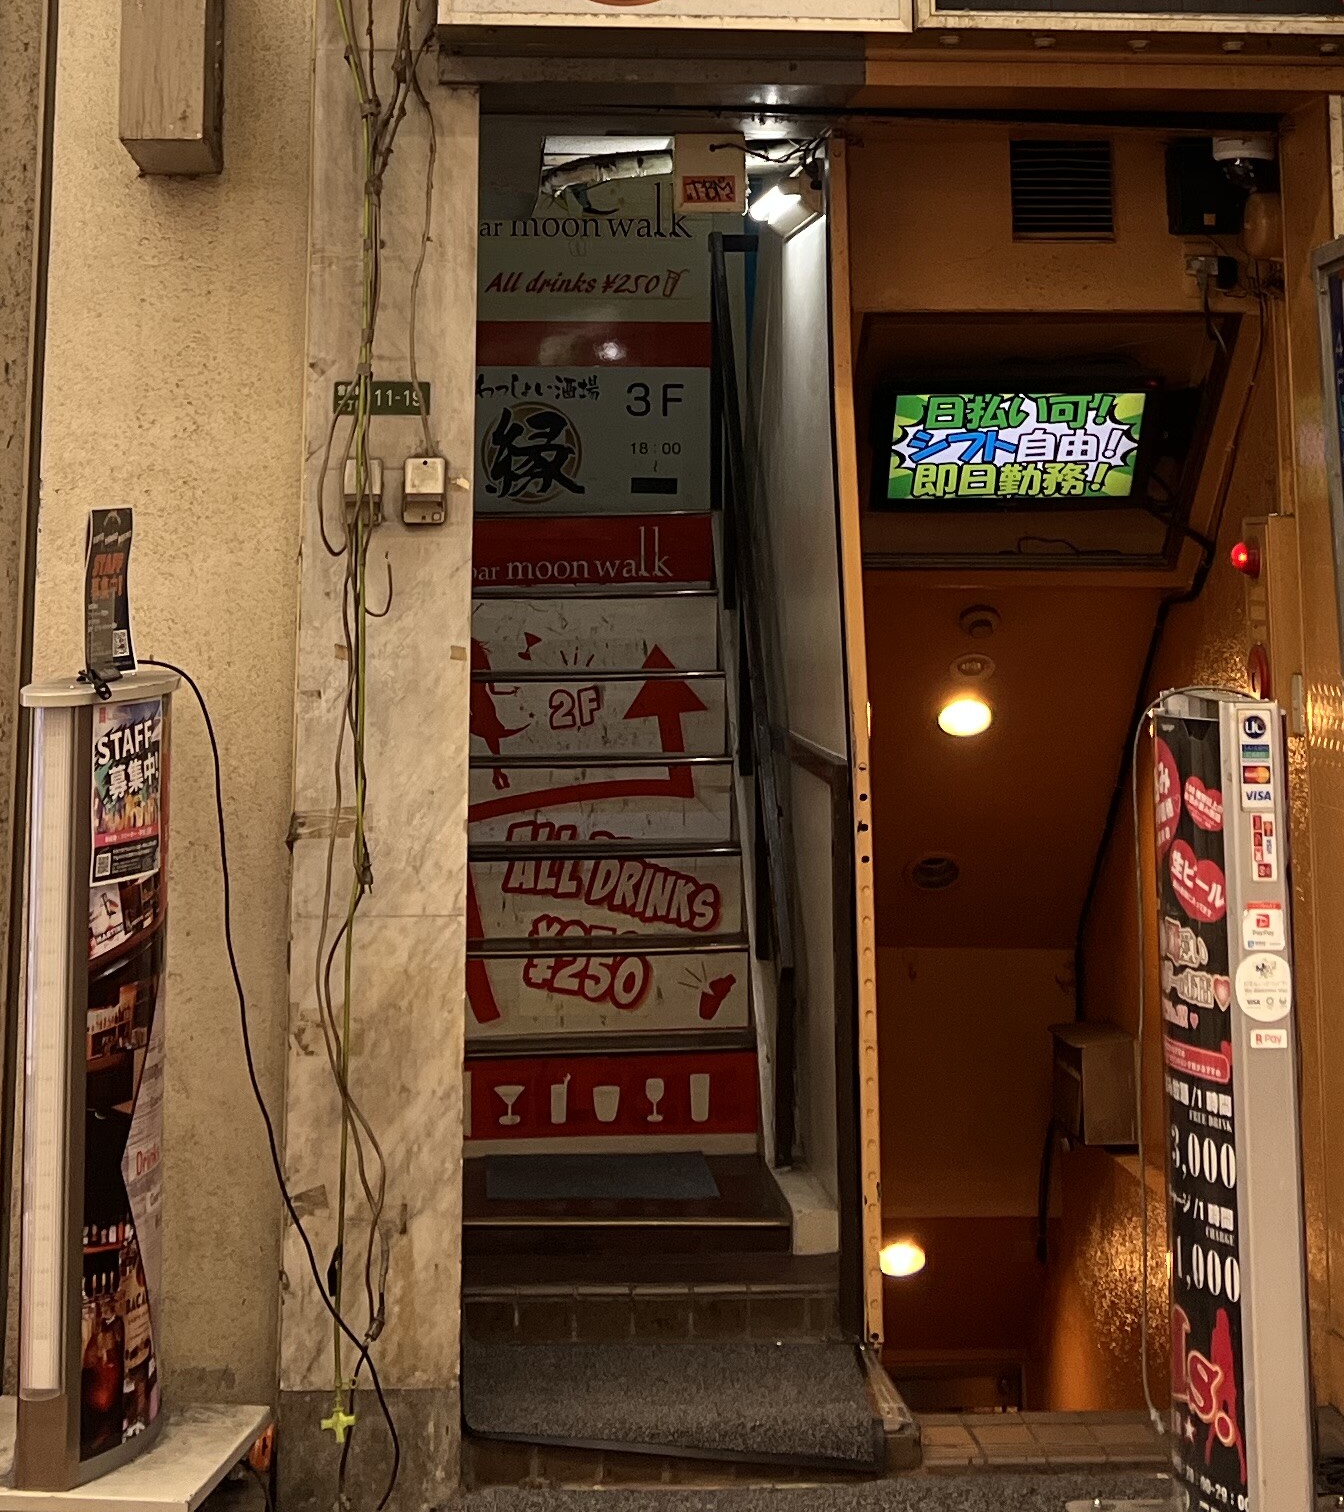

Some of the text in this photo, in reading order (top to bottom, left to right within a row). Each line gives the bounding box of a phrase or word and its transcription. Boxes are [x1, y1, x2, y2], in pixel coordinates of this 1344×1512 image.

[479, 221, 503, 238] ar
[509, 217, 601, 238] moon
[485, 270, 660, 294] All drinks ¥250
[476, 374, 599, 401] わっしょい酒場
[626, 383, 685, 417] 3F
[485, 407, 585, 499] 縁
[630, 442, 682, 455] 18:00
[506, 558, 590, 580] moon
[594, 526, 673, 577] walk
[548, 685, 601, 730] 2F
[97, 718, 153, 766] STAFF
[109, 751, 160, 800] 募集中!
[1246, 791, 1271, 800] VISA
[502, 820, 721, 932] ALL DRINKS
[1171, 851, 1225, 907] 生ビール
[523, 914, 654, 1010] ¥250
[1264, 1035, 1282, 1046] Pay
[1171, 1124, 1236, 1189] 3,000
[1176, 1236, 1241, 1303] 1,000
